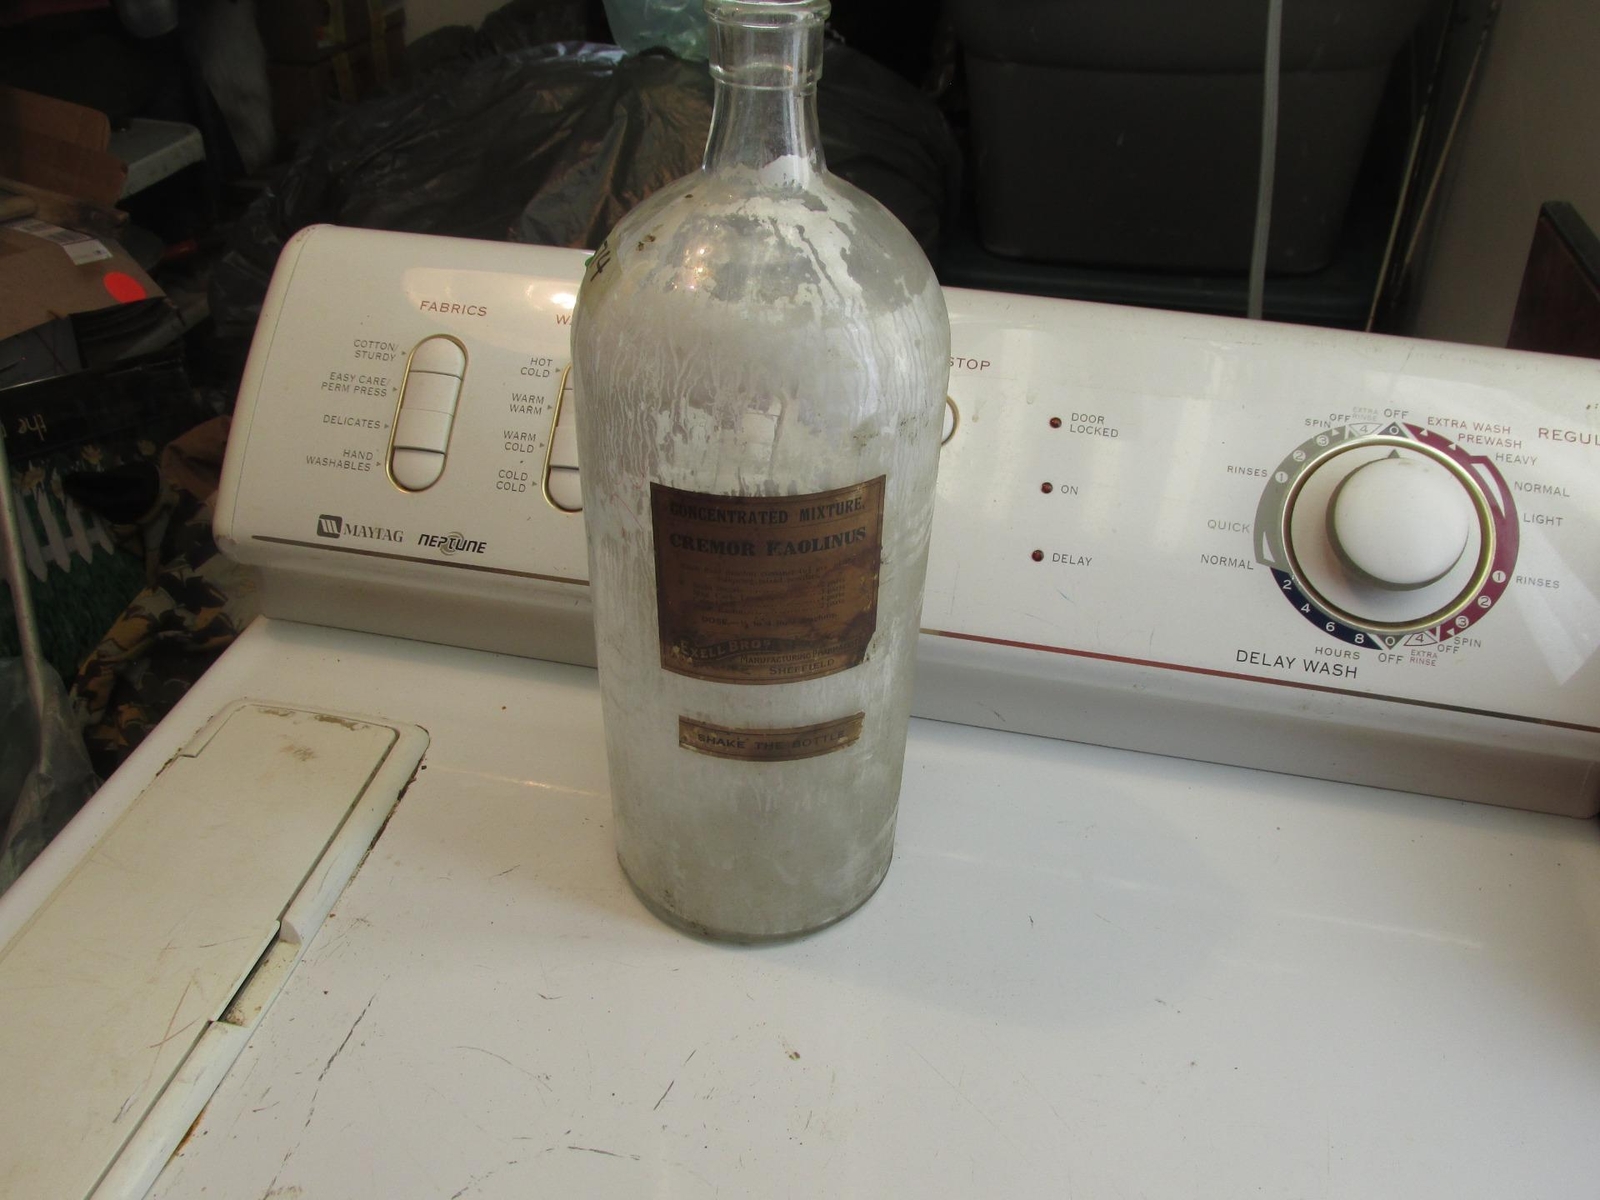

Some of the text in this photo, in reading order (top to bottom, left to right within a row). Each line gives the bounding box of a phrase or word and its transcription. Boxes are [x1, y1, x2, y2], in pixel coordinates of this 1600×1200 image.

[420, 300, 487, 317] FABRICS
[353, 339, 399, 351] COTTON/
[354, 350, 396, 361] STURDY
[530, 358, 553, 367] HOT
[949, 357, 991, 371] STOP
[520, 367, 550, 378] COLD
[329, 372, 391, 386] EASY CARE/
[321, 382, 387, 397] PERM PRESS
[512, 393, 544, 405] WARM
[509, 404, 542, 416] WARM
[1383, 408, 1409, 419] OFF
[323, 414, 381, 429] DELICATES
[1071, 412, 1105, 424] DOOR
[1304, 418, 1331, 428] SPIN
[1329, 413, 1351, 423] OFF
[1070, 424, 1119, 438] LOCKED
[1360, 425, 1368, 433] 4
[1427, 416, 1511, 434] EXTRA WASH
[503, 430, 536, 442] WARM
[1318, 436, 1327, 445] 3
[1458, 433, 1522, 449] PREWASH
[504, 442, 534, 454] COLD
[343, 449, 373, 461] HAND
[1295, 451, 1303, 461] 2
[1495, 452, 1538, 466] HEAVY
[306, 455, 371, 472] WASHABLES
[498, 470, 528, 482] COLD
[1227, 465, 1268, 478] RINSES
[496, 481, 526, 493] COLD
[1061, 484, 1079, 495] ON
[1514, 481, 1570, 498] NORMAL
[670, 500, 788, 525] CONCENTRATED
[1523, 513, 1564, 526] LIGHT
[1207, 519, 1250, 533] QUICK
[343, 523, 404, 542] MAYTAG
[418, 534, 487, 554] NEPTUNE
[669, 533, 756, 556] CREMOR
[1052, 552, 1092, 566] DELAY
[1201, 554, 1254, 570] NORMAL
[1283, 580, 1292, 590] 2
[1516, 576, 1560, 589] RINSES
[1480, 597, 1489, 606] 2
[1301, 603, 1311, 613] 4
[1326, 622, 1335, 632] 6
[1458, 618, 1467, 627] 3
[1354, 634, 1365, 644] 8
[1415, 633, 1424, 643] 4
[1454, 637, 1481, 648] SPIN
[1315, 646, 1361, 660] HOURS
[1410, 650, 1438, 659] EXTRA
[1437, 644, 1460, 654] OFF
[1236, 649, 1358, 679] DELAY WASH
[1378, 652, 1404, 665] OFF
[1410, 657, 1436, 667] RINSE
[769, 659, 835, 676] SHEFFIELD
[698, 733, 746, 748] SHAKE
